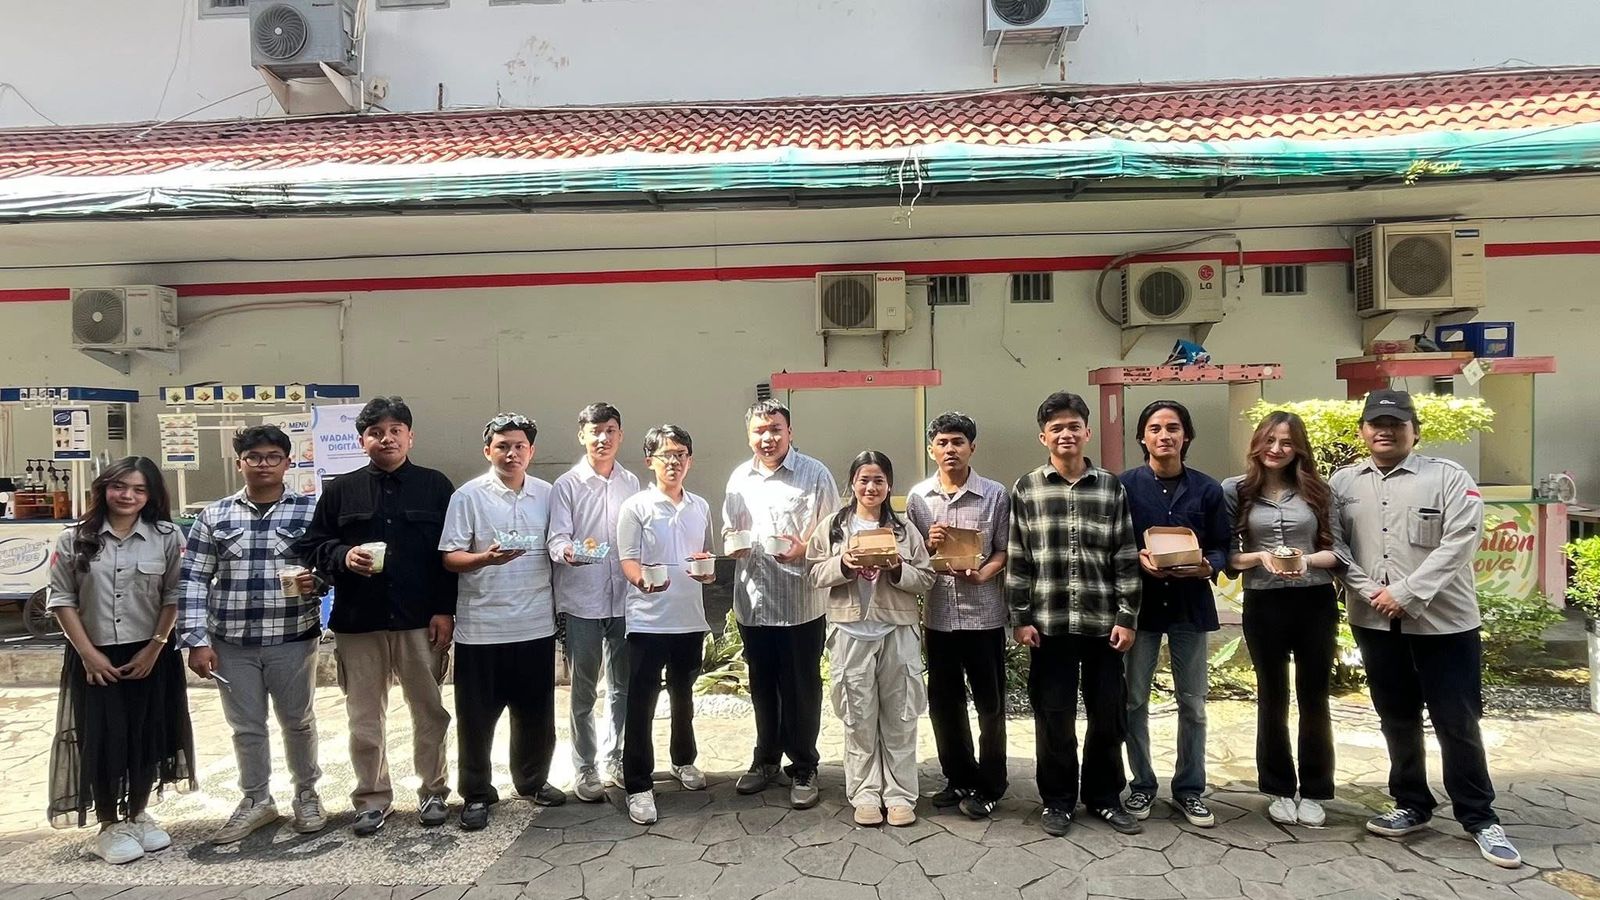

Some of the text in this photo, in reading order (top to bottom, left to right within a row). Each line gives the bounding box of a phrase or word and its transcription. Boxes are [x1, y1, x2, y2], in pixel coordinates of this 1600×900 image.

[1199, 282, 1213, 290] LG
[288, 421, 309, 429] MENU
[319, 433, 354, 443] WADAH
